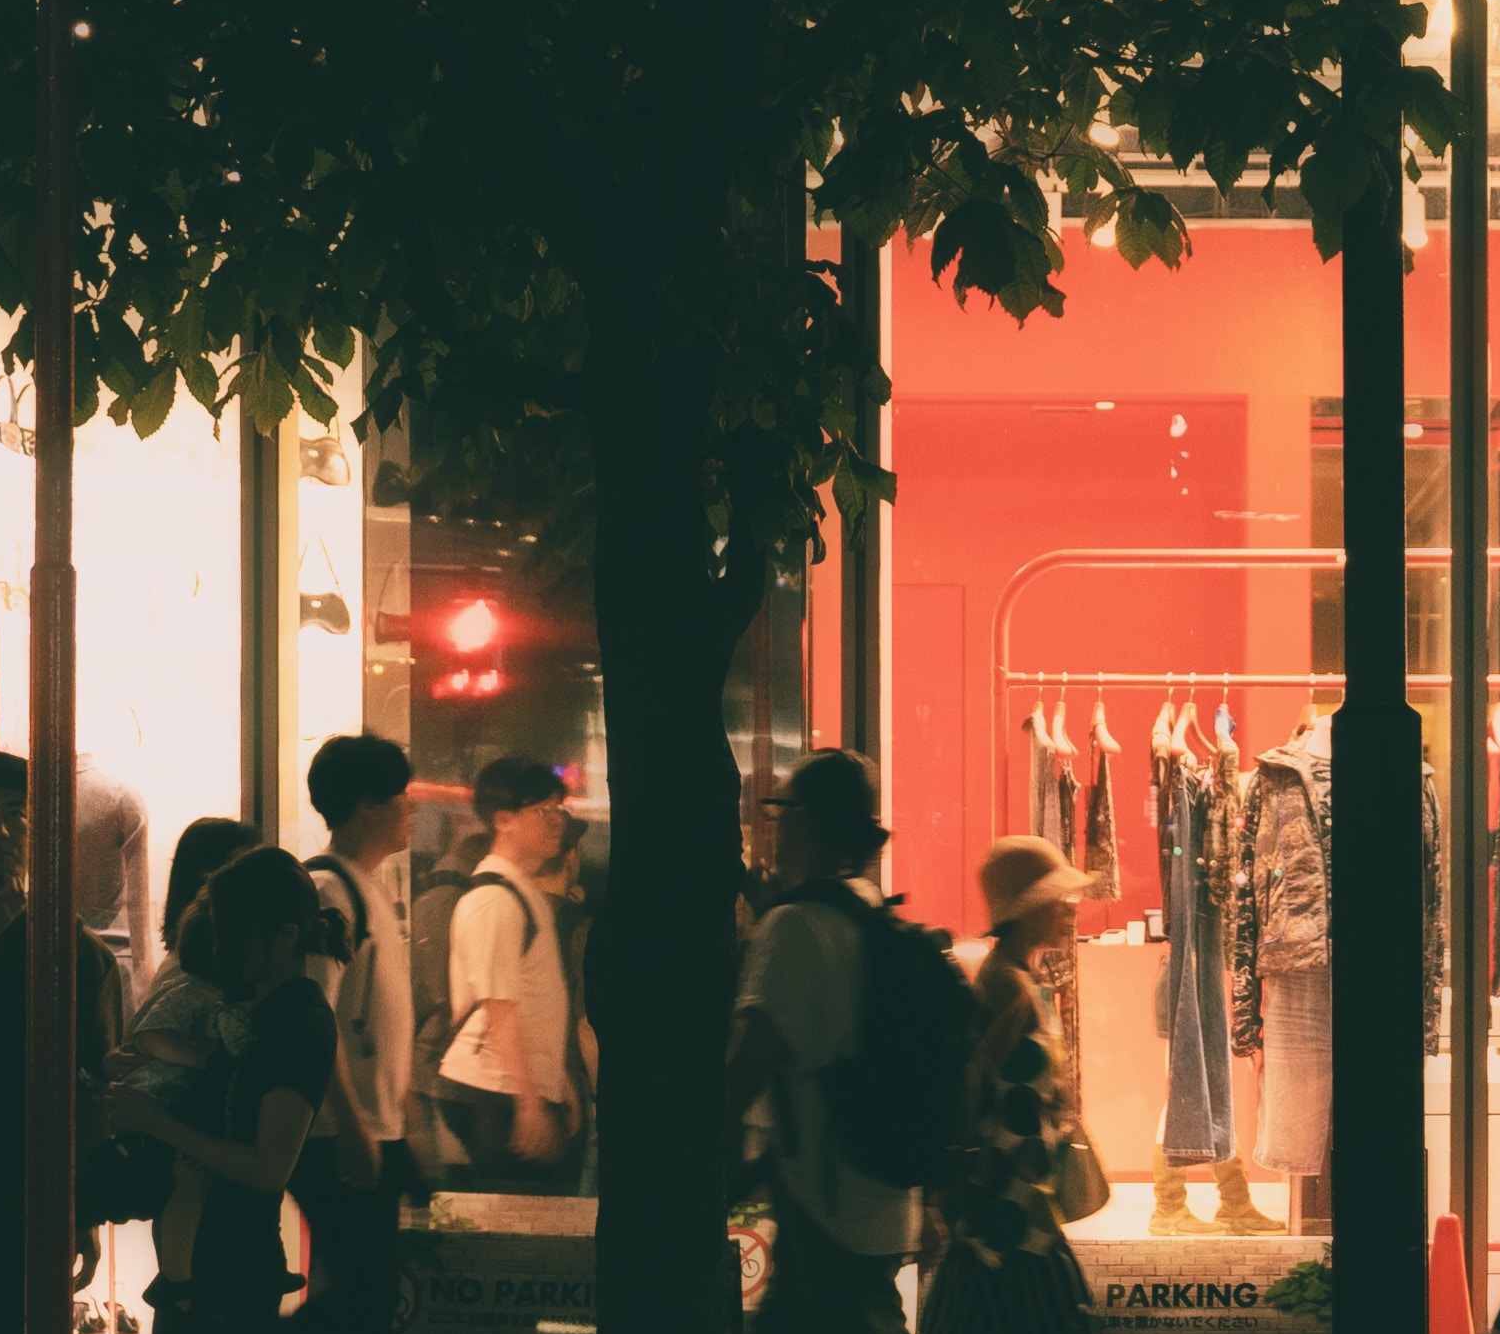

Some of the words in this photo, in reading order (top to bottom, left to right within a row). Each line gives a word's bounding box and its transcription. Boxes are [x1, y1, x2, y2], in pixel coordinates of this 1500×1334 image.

[430, 1278, 483, 1304] NO
[495, 1279, 596, 1308] PARKI
[1106, 1282, 1259, 1308] PARKING
